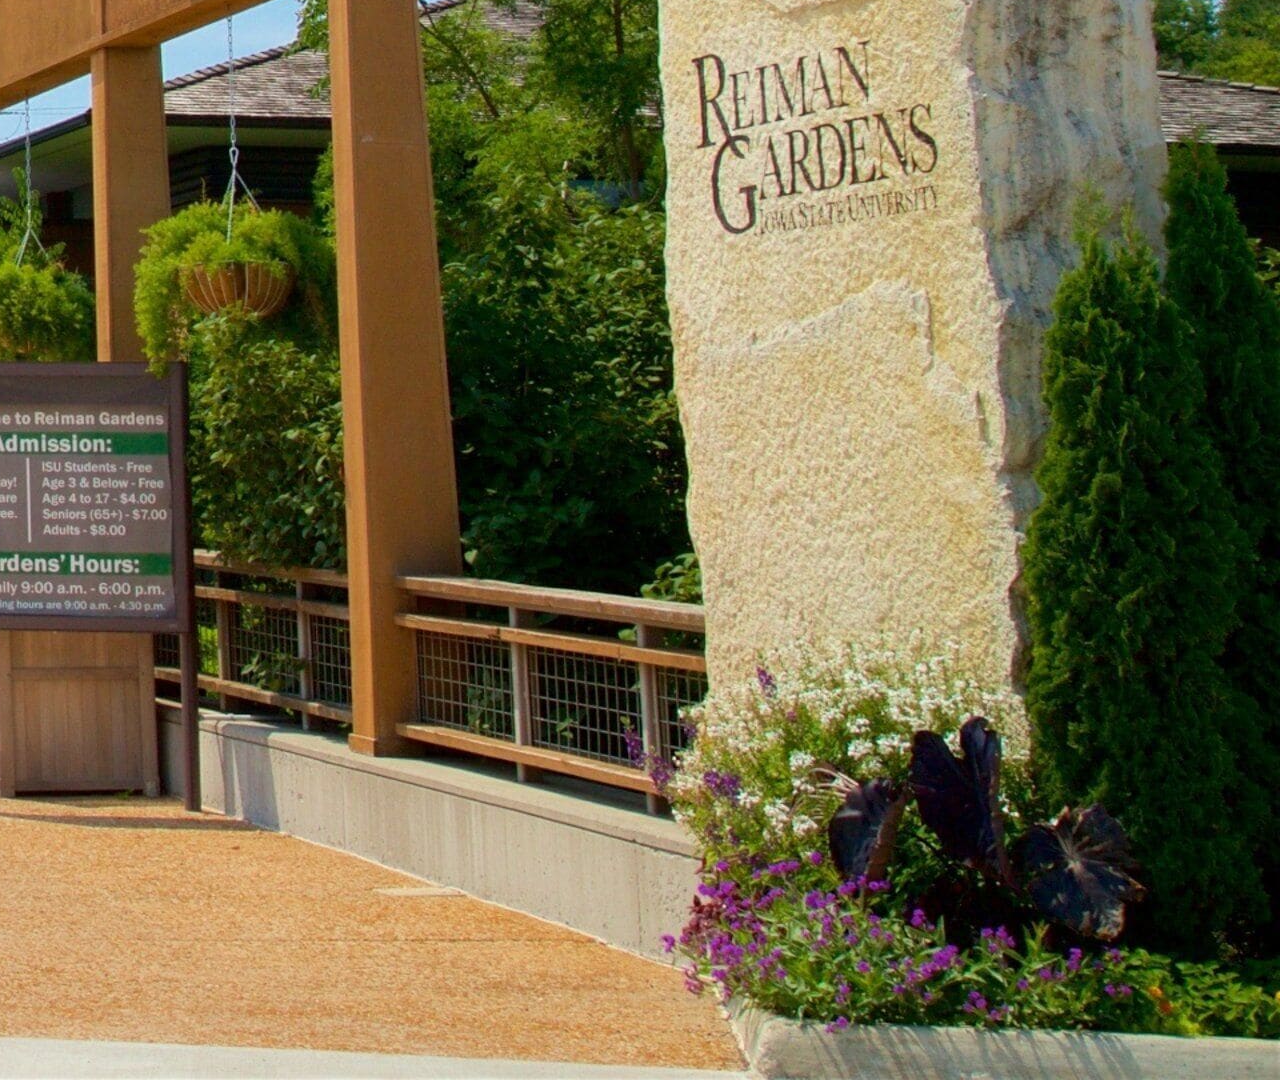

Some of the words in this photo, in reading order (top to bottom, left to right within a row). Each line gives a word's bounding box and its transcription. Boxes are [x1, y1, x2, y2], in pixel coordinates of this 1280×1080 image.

[15, 412, 30, 426] to
[34, 411, 95, 425] Reiman
[99, 411, 164, 426] Gardens
[42, 461, 61, 473] ISU
[64, 461, 117, 473] Students
[127, 461, 153, 473] Free
[42, 477, 65, 491] Age
[68, 477, 76, 489] 3
[79, 477, 90, 489] &
[92, 477, 128, 489] Below
[138, 478, 164, 489] Free
[42, 493, 66, 506] Age
[68, 493, 77, 504] 4
[79, 494, 92, 504] to
[95, 493, 110, 504] 17
[120, 493, 157, 505] $4.00
[42, 508, 88, 520] Seniors
[90, 509, 123, 521] (65+)
[132, 509, 168, 521] $7.00
[43, 524, 80, 536] Adults
[90, 524, 127, 537] $8.00
[69, 555, 141, 574] Hours:
[21, 582, 54, 595] 9:00
[57, 584, 88, 595] a.m.
[98, 583, 132, 596] 6:00
[135, 586, 166, 599] p.m.
[16, 601, 44, 611] hours
[45, 602, 63, 611] are
[64, 600, 88, 611] 9:00
[89, 602, 112, 612] a.m.
[119, 601, 143, 611] 4:30
[144, 602, 166, 614] p.m.
